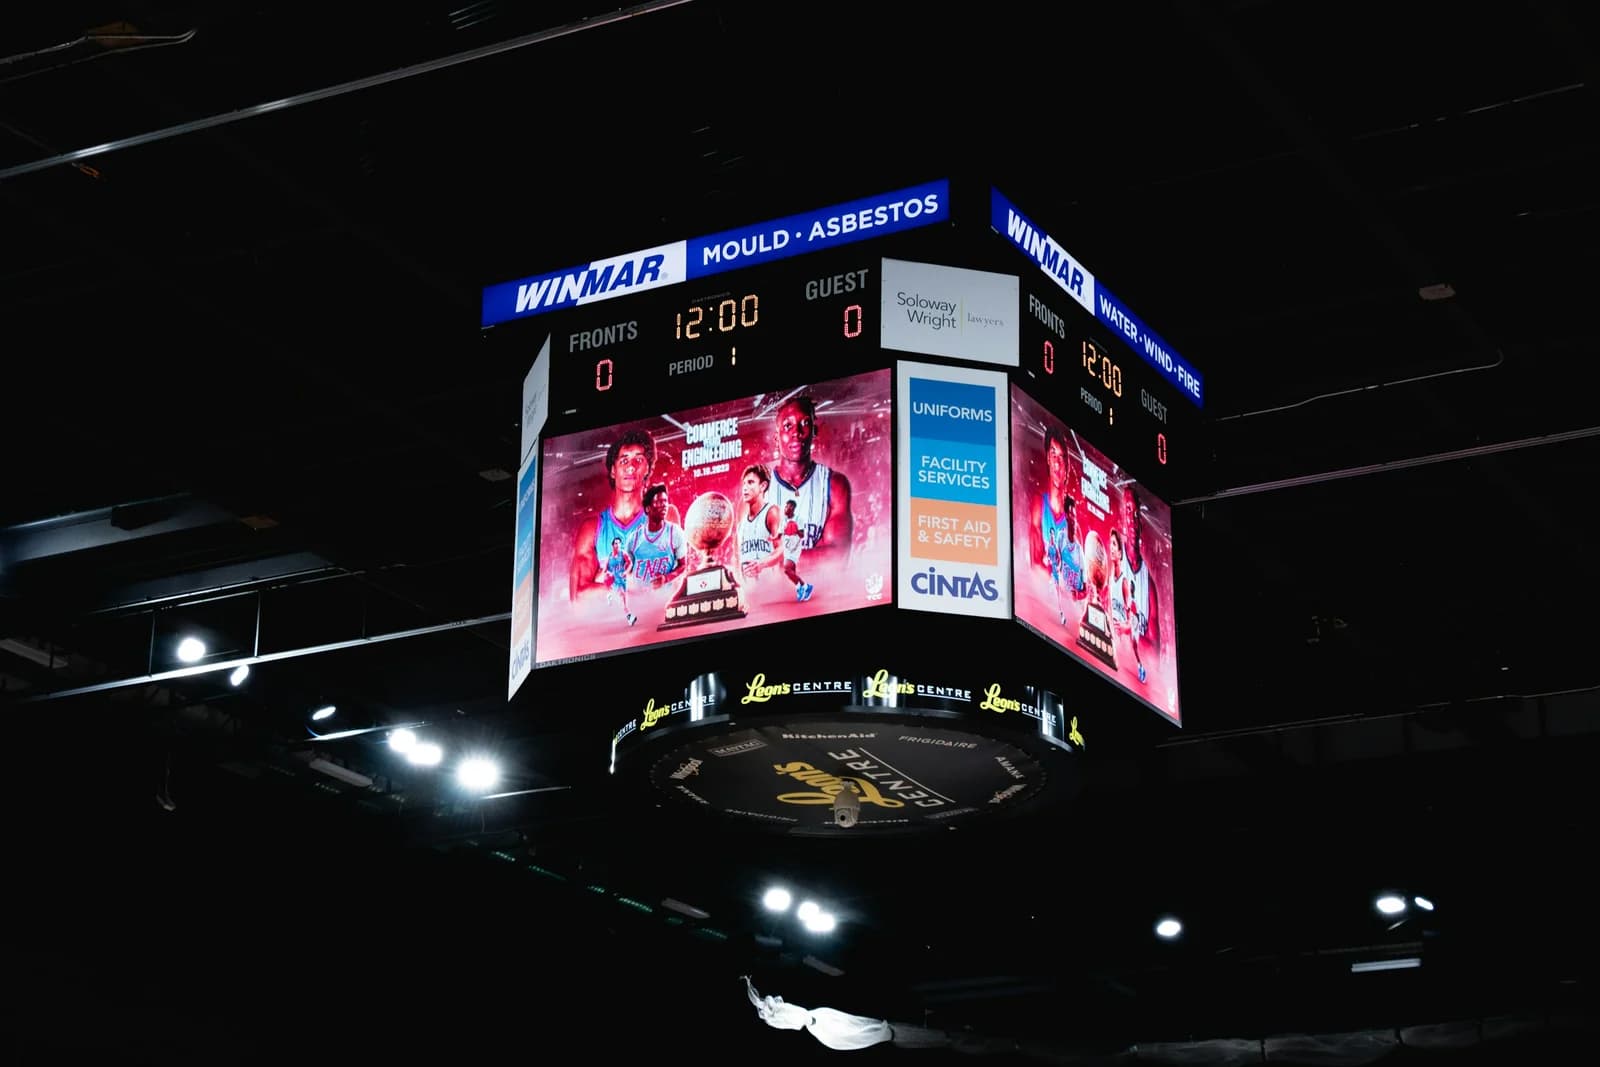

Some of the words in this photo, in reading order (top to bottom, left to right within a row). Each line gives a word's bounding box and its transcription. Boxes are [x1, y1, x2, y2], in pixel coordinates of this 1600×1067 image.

[703, 229, 790, 266] MOULD
[808, 194, 938, 241] ASBESTOS
[1007, 208, 1084, 297] WINMAR
[515, 254, 665, 313] WINMAR
[805, 269, 868, 300] GUEST
[676, 294, 759, 339] 12:00
[897, 292, 956, 316] Soloway
[1029, 294, 1065, 339] FRONTS
[844, 305, 862, 338] 0
[907, 309, 956, 330] Wright
[967, 312, 1004, 327] lawyers
[569, 320, 638, 353] FRONTS
[1100, 294, 1137, 344] WATER
[1144, 334, 1173, 373] WIND
[1178, 366, 1200, 398] FIRE
[669, 355, 714, 376] PERIOD
[731, 346, 736, 366] 1
[1044, 340, 1054, 375] 0
[1083, 341, 1122, 398] 12:00
[596, 359, 613, 391] 0
[913, 402, 993, 422] UNIFORMS
[1080, 387, 1103, 415] PERIOD
[1141, 389, 1168, 425] GUEST
[1109, 407, 1113, 425] 1
[686, 417, 739, 445] COMMERCE
[682, 439, 742, 469] ENGINEERING
[1157, 433, 1167, 465] 0
[918, 469, 990, 489] SERVICES
[921, 456, 987, 474] FACILITY
[918, 515, 959, 532] FIRST
[963, 518, 991, 535] AID
[918, 530, 929, 543] &
[933, 531, 991, 548] SAFETY
[671, 694, 715, 712] CENRE
[741, 673, 791, 704] Leon's
[793, 681, 852, 693] CENTRE
[917, 684, 971, 700] CENTRE
[781, 732, 876, 740] KitchenAid
[898, 735, 978, 750] FRIGIDAIRE
[827, 749, 945, 808] CENTRE
